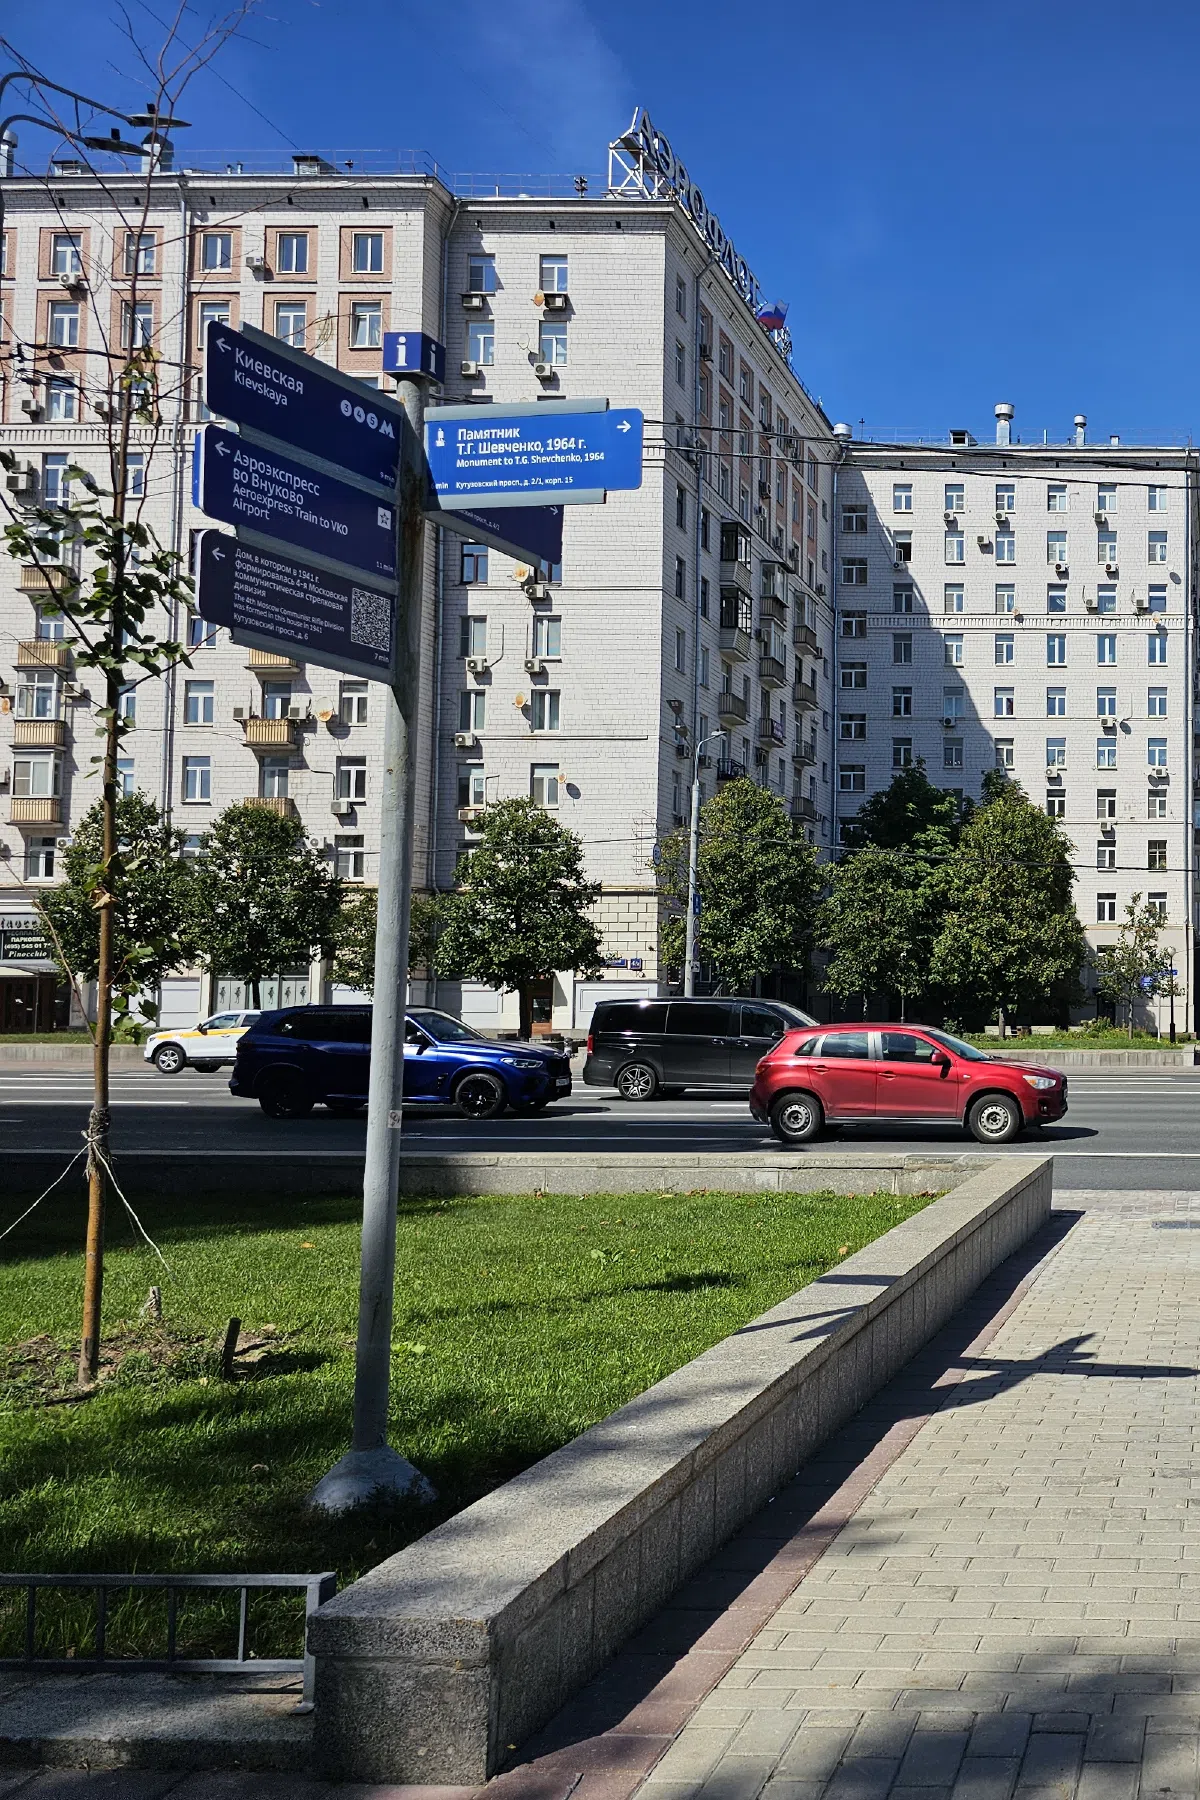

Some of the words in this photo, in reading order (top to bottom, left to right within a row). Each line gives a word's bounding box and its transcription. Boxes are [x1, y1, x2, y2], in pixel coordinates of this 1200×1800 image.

[236, 348, 304, 394] Киевская
[234, 370, 288, 405] Kievskaya
[458, 428, 520, 440] Памятник
[456, 443, 476, 455] Т.Г.
[478, 440, 544, 454] Шевченко,
[546, 438, 576, 450] 1964
[578, 438, 586, 448] г.
[456, 457, 502, 468] Monument
[504, 457, 513, 465] to
[514, 456, 530, 464] T.G.
[531, 452, 582, 464] Shevchenko,
[584, 452, 604, 462] 1964
[234, 450, 320, 496] Аэроэкспресс
[456, 480, 498, 490] Кутузовский
[544, 478, 564, 486] корп.
[233, 468, 248, 484] во
[252, 473, 304, 505] Внуково
[233, 498, 270, 520] Airport
[233, 483, 294, 514] Aeroexpress
[294, 506, 318, 524] Train
[320, 517, 330, 529] to
[331, 520, 348, 536] VKO
[235, 548, 254, 562] Дом,
[260, 558, 292, 574] котором
[299, 570, 314, 582] 1941
[234, 582, 266, 597] дивизия
[234, 570, 304, 598] коммунистическая
[305, 594, 344, 611] стрелковая
[235, 560, 294, 586] формировалась
[296, 580, 308, 590] 4-я
[308, 583, 348, 603] Московская
[234, 593, 244, 602] The
[234, 612, 274, 630] Кутузовский
[246, 604, 267, 618] formed
[274, 614, 285, 622] this
